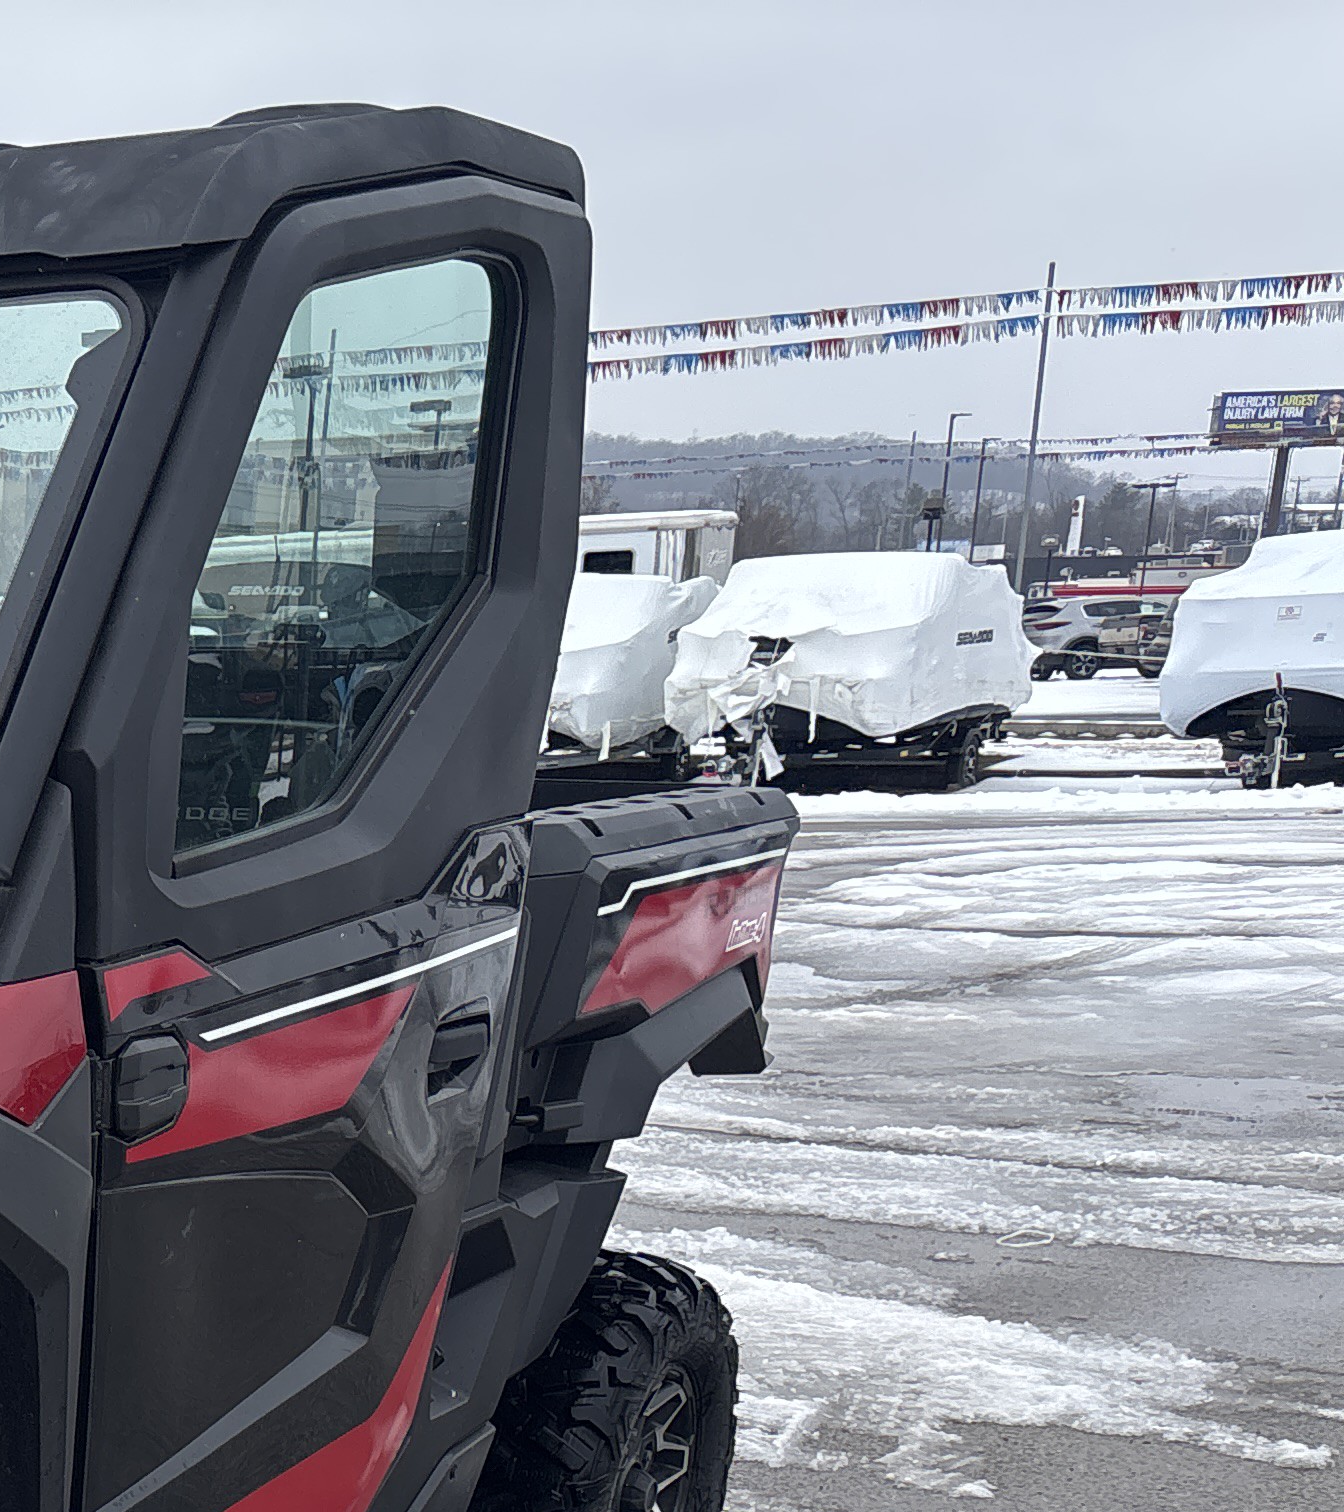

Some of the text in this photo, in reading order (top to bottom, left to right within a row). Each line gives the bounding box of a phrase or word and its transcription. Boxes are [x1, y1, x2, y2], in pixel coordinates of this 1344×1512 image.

[1226, 394, 1320, 407] AMERICA'S LARGEST
[1224, 406, 1305, 420] INJURY LAW FIRM
[227, 585, 305, 596] SEA-DOO
[185, 806, 251, 820] DGE
